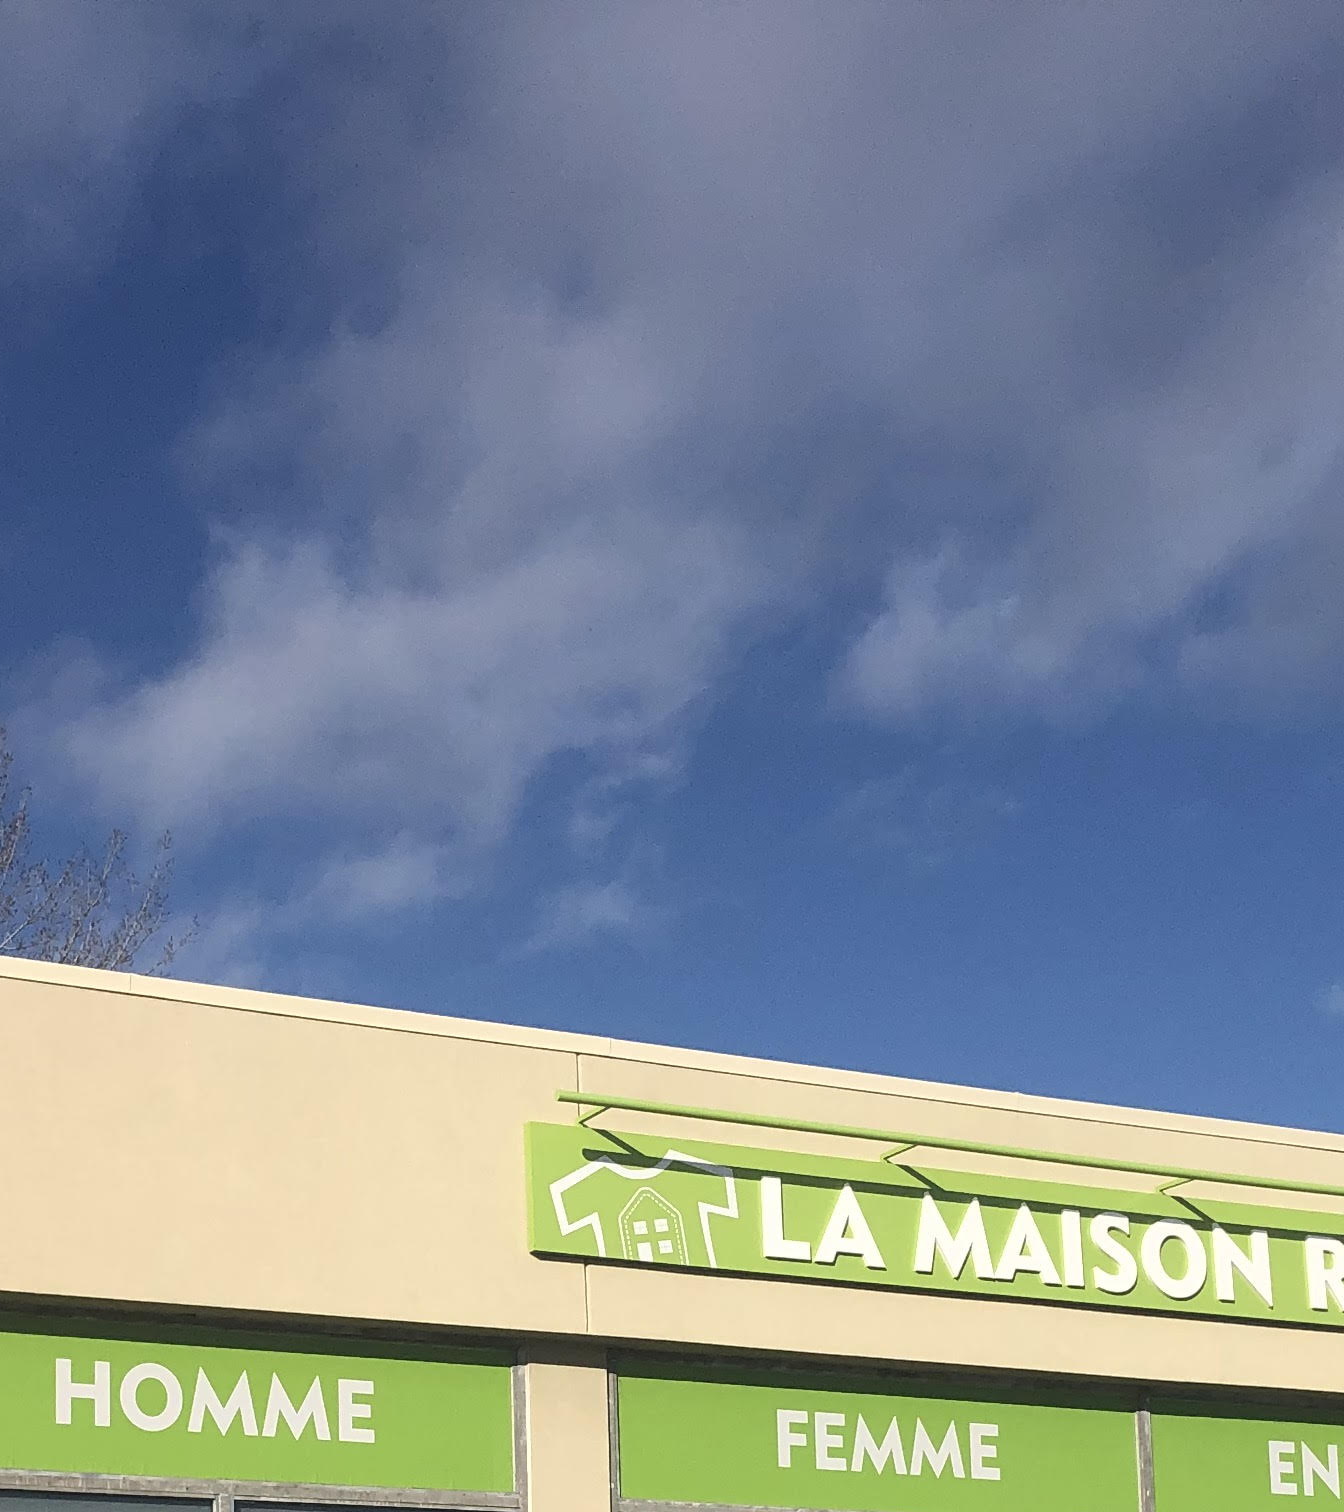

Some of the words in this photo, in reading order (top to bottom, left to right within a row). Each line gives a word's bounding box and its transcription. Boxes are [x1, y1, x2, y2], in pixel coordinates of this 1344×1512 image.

[761, 1176, 887, 1271] LA
[913, 1190, 1274, 1308] MAISON
[55, 1358, 376, 1445] HOMME
[775, 1408, 1002, 1482] FEMME
